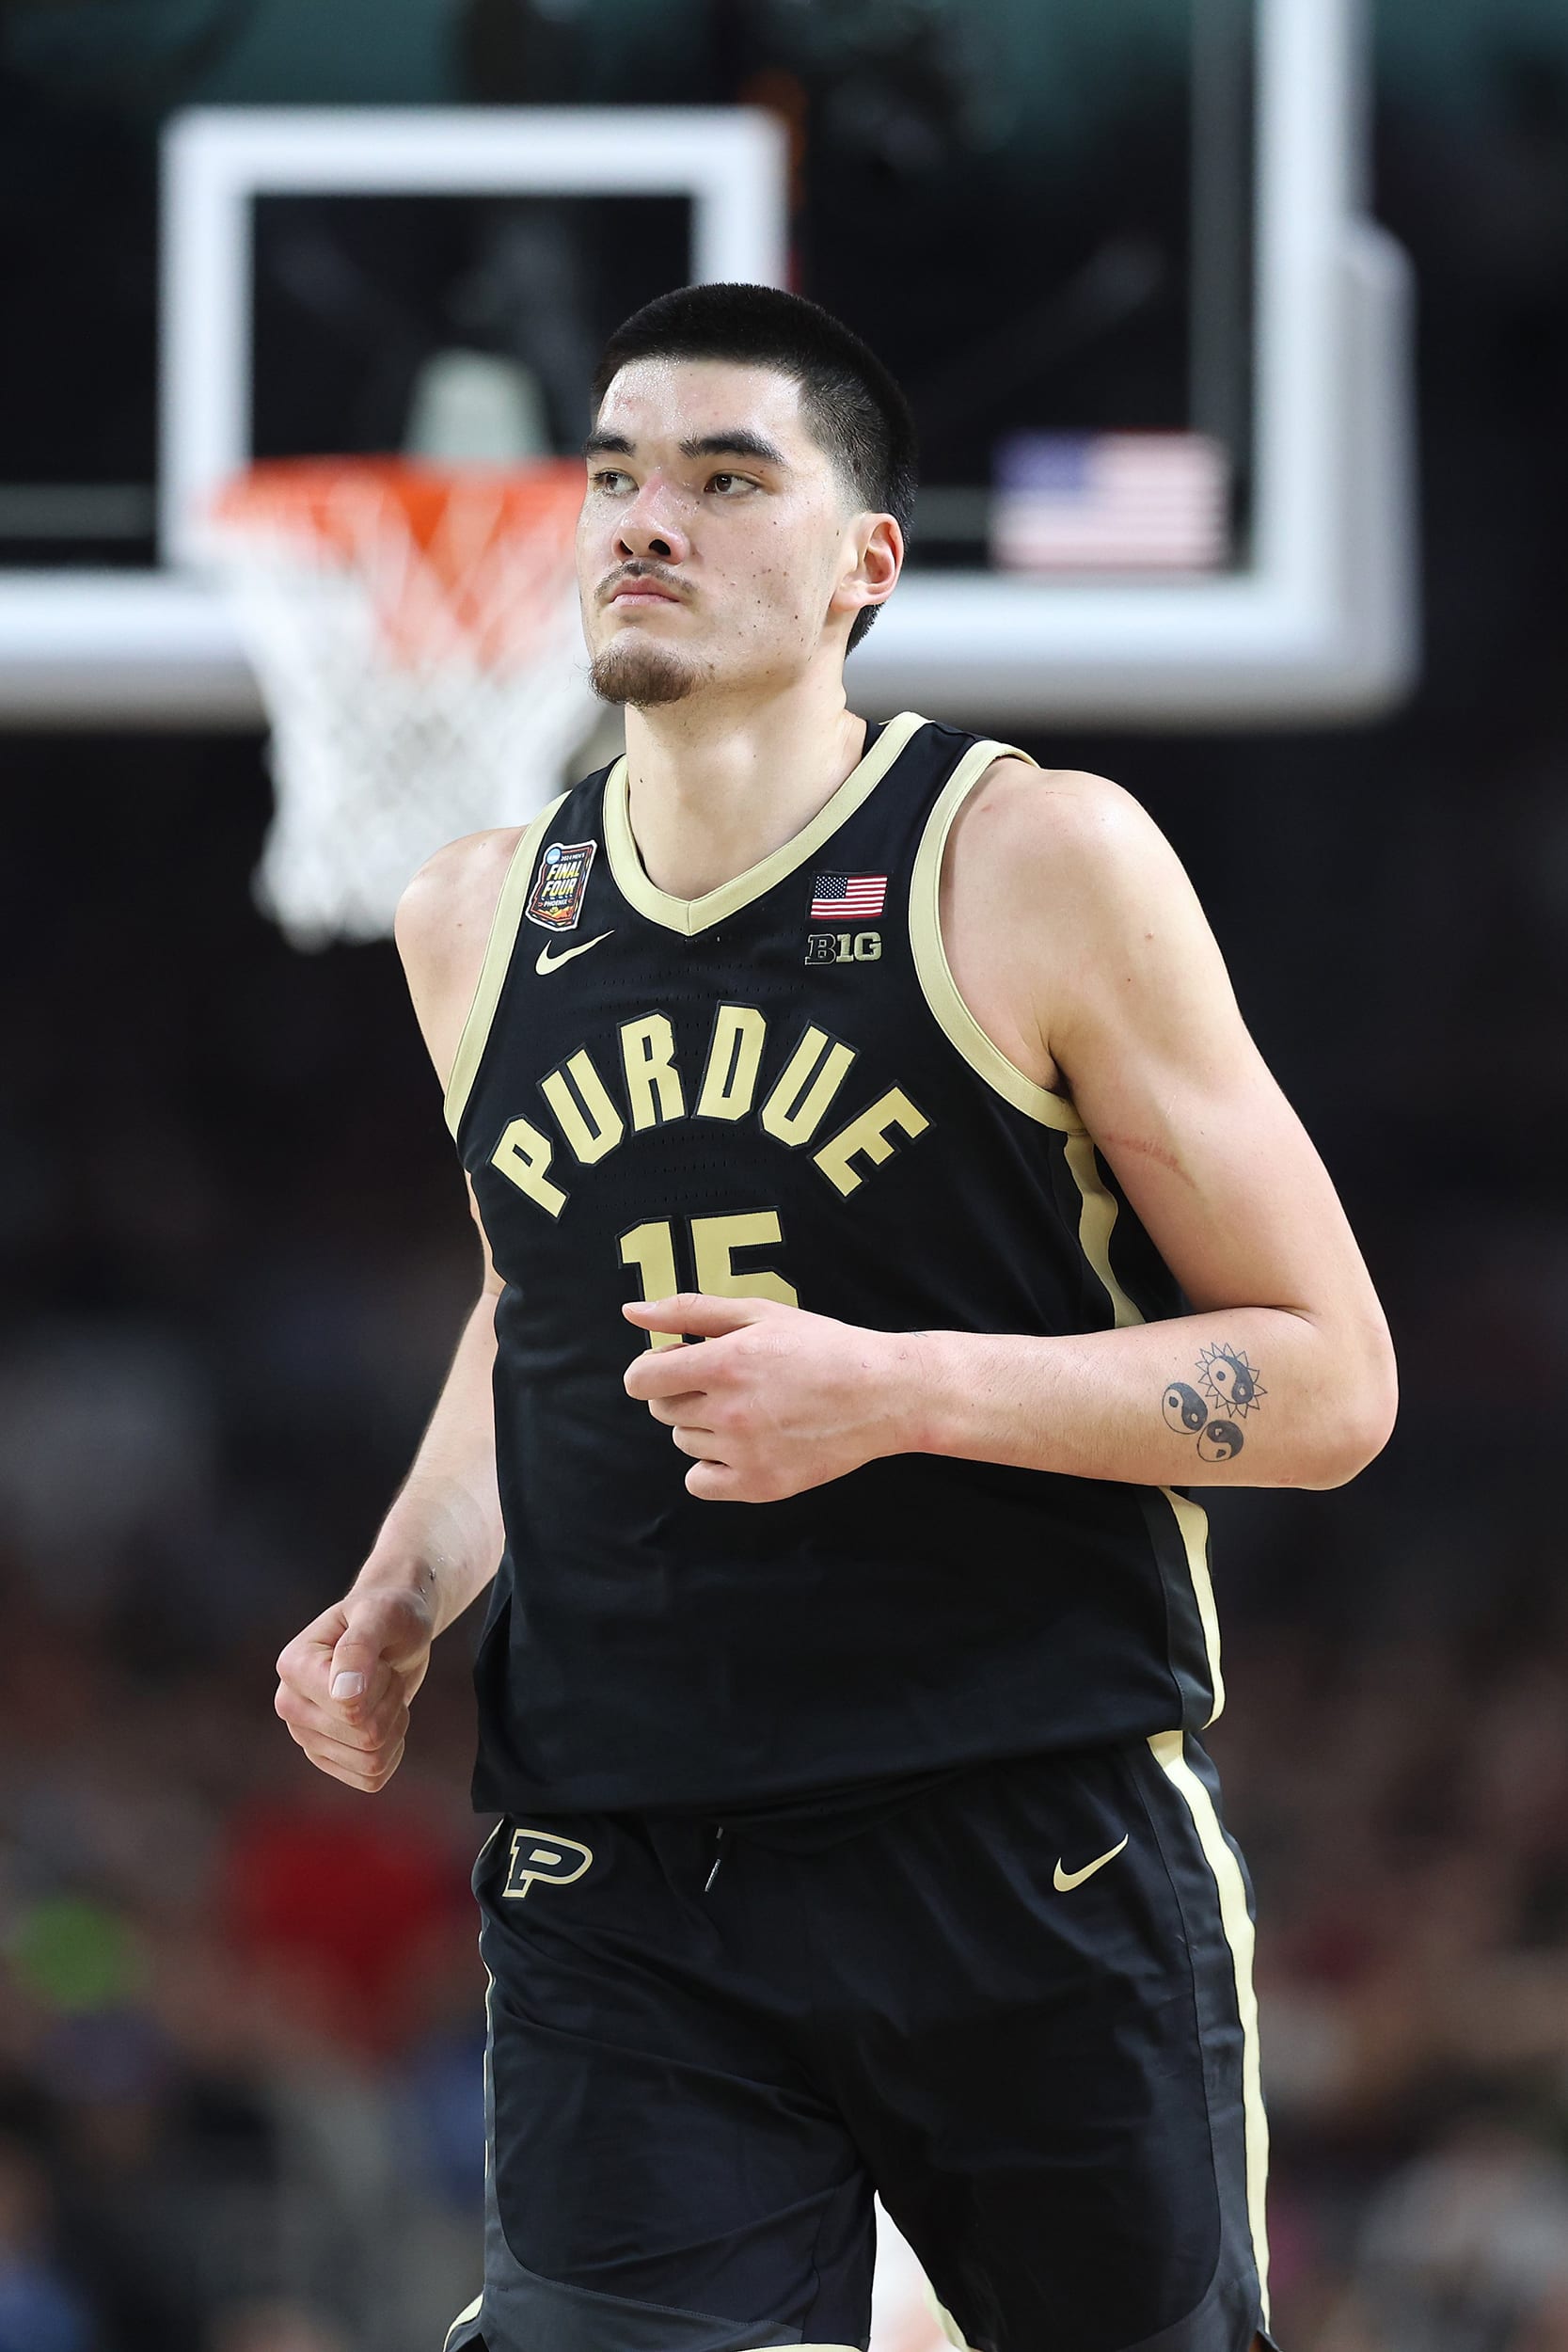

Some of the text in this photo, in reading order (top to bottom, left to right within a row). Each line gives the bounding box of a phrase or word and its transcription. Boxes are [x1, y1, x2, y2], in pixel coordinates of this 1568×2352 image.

[542, 878, 578, 898] FOUR
[546, 861, 582, 881] FINAL
[488, 1003, 932, 1219] PURDUE
[618, 1210, 800, 1353] 15
[502, 1828, 594, 1899] P
